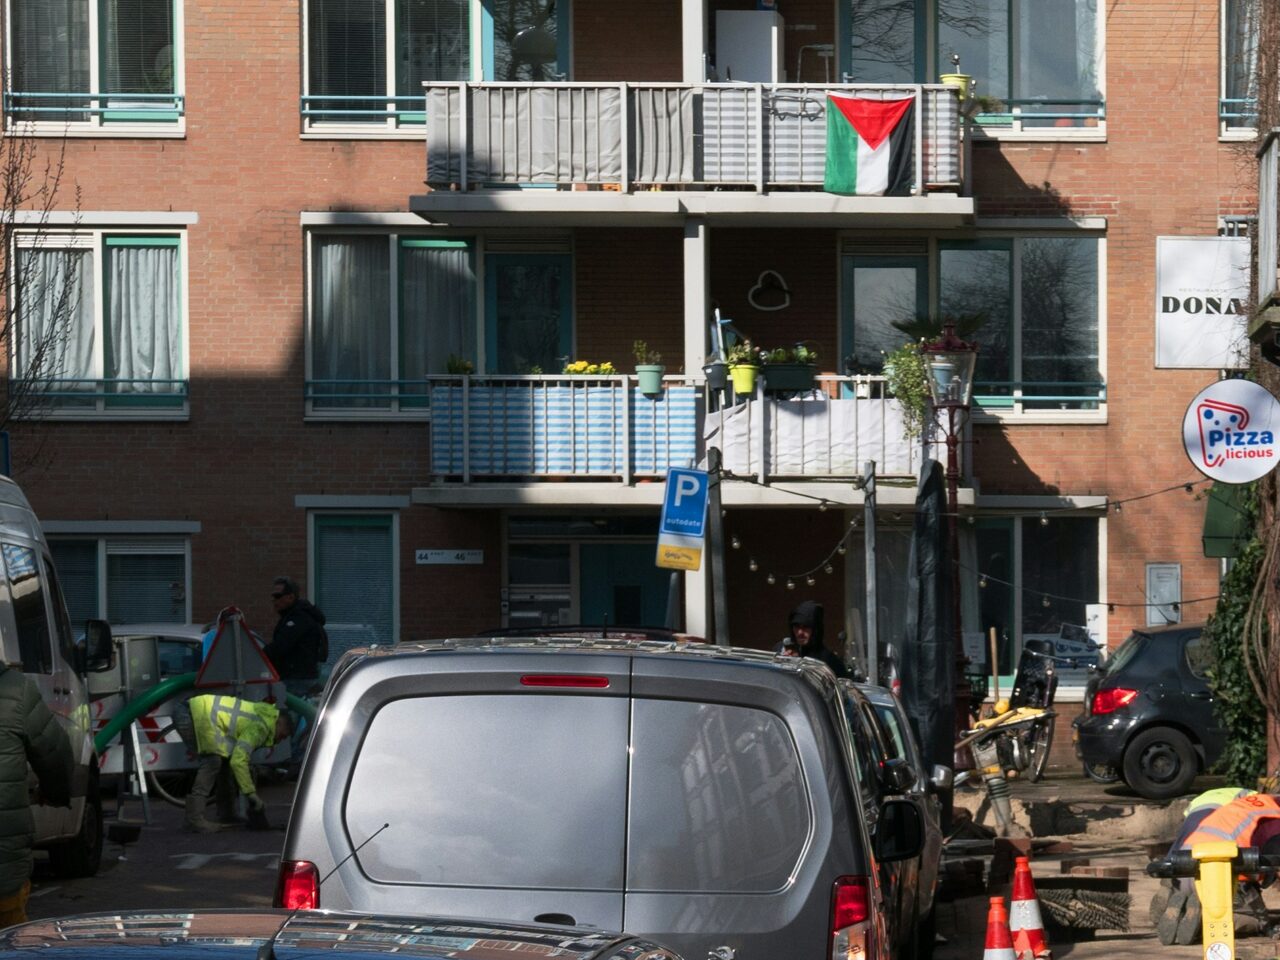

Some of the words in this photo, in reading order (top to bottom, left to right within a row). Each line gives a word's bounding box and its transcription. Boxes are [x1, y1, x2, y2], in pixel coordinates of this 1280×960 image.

[1162, 296, 1243, 315] DONA
[1209, 427, 1274, 447] Pizza
[1226, 447, 1273, 459] licious
[674, 474, 700, 507] P
[666, 518, 701, 527] autodate
